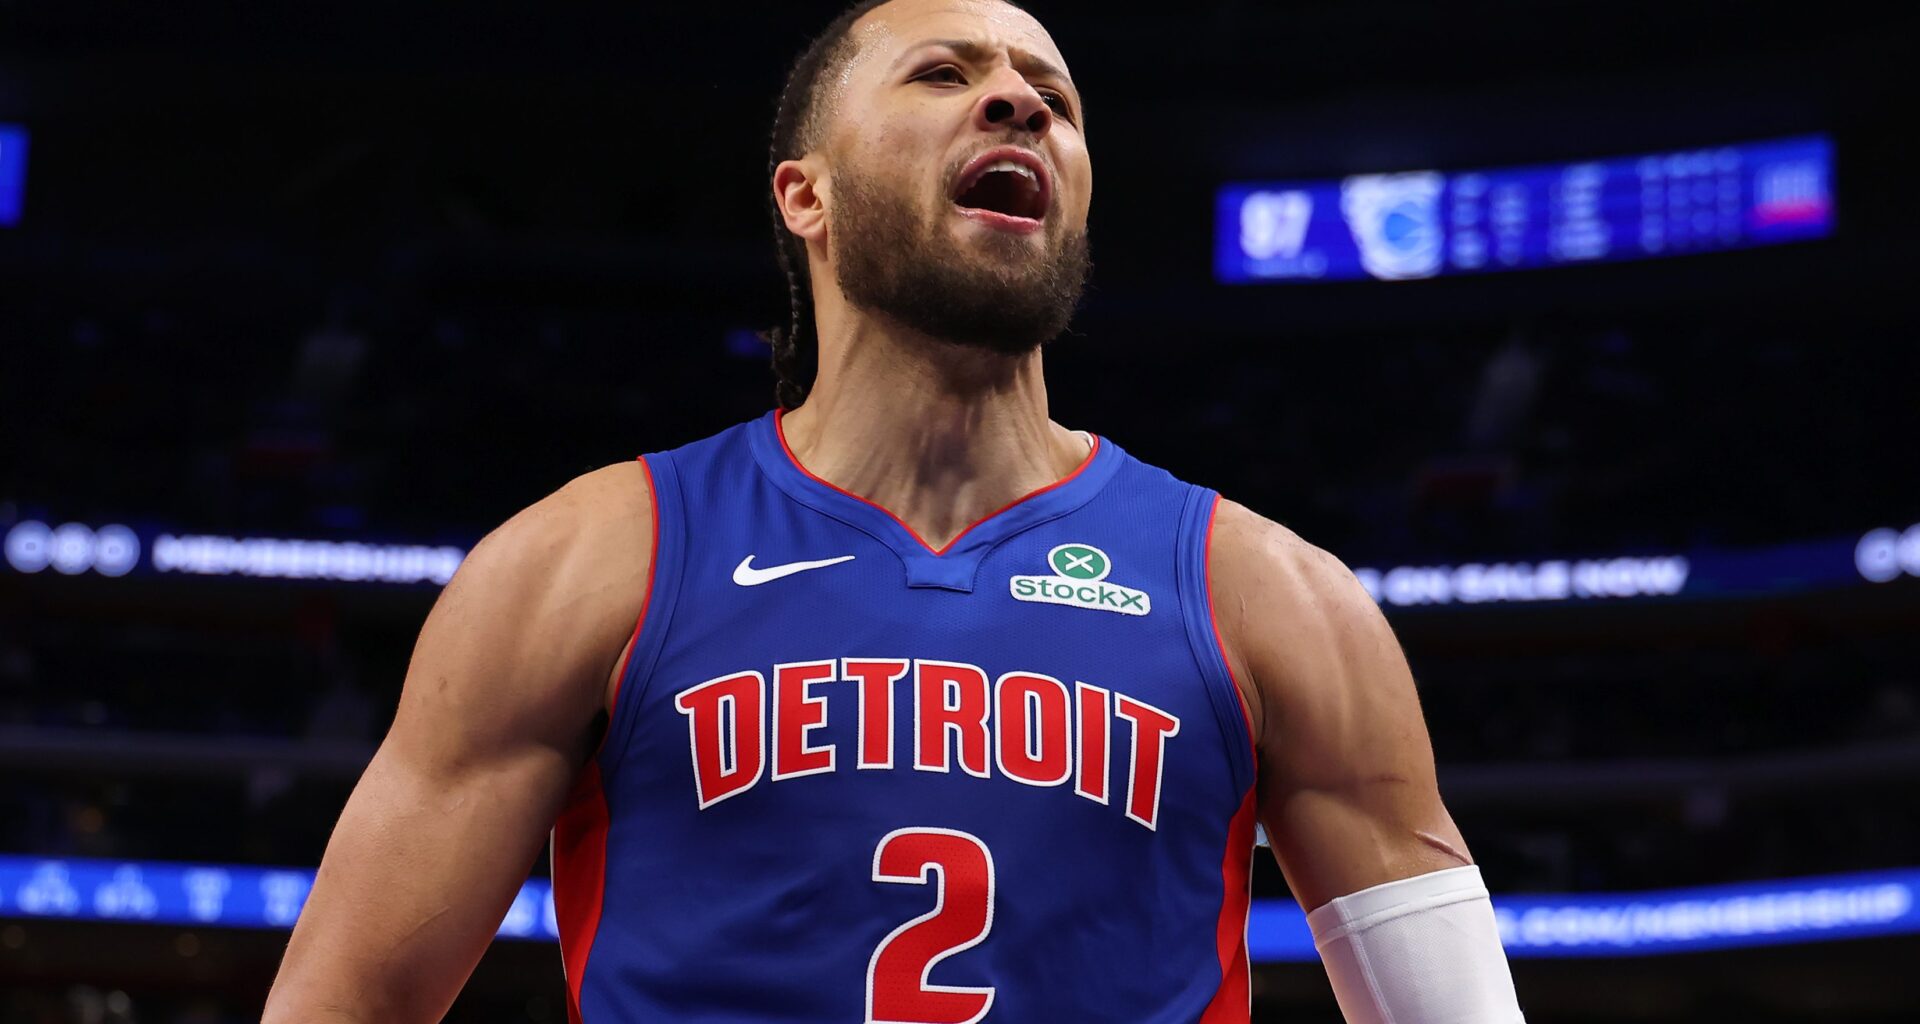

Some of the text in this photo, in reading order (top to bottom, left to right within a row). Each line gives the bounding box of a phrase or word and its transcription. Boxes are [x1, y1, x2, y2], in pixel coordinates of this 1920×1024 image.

[1015, 578, 1144, 611] StockX
[1383, 565, 1450, 605] ON
[1453, 561, 1568, 601] SALE
[1573, 556, 1688, 598] NOW
[675, 657, 1181, 832] DETROIT
[865, 826, 996, 1024] 2
